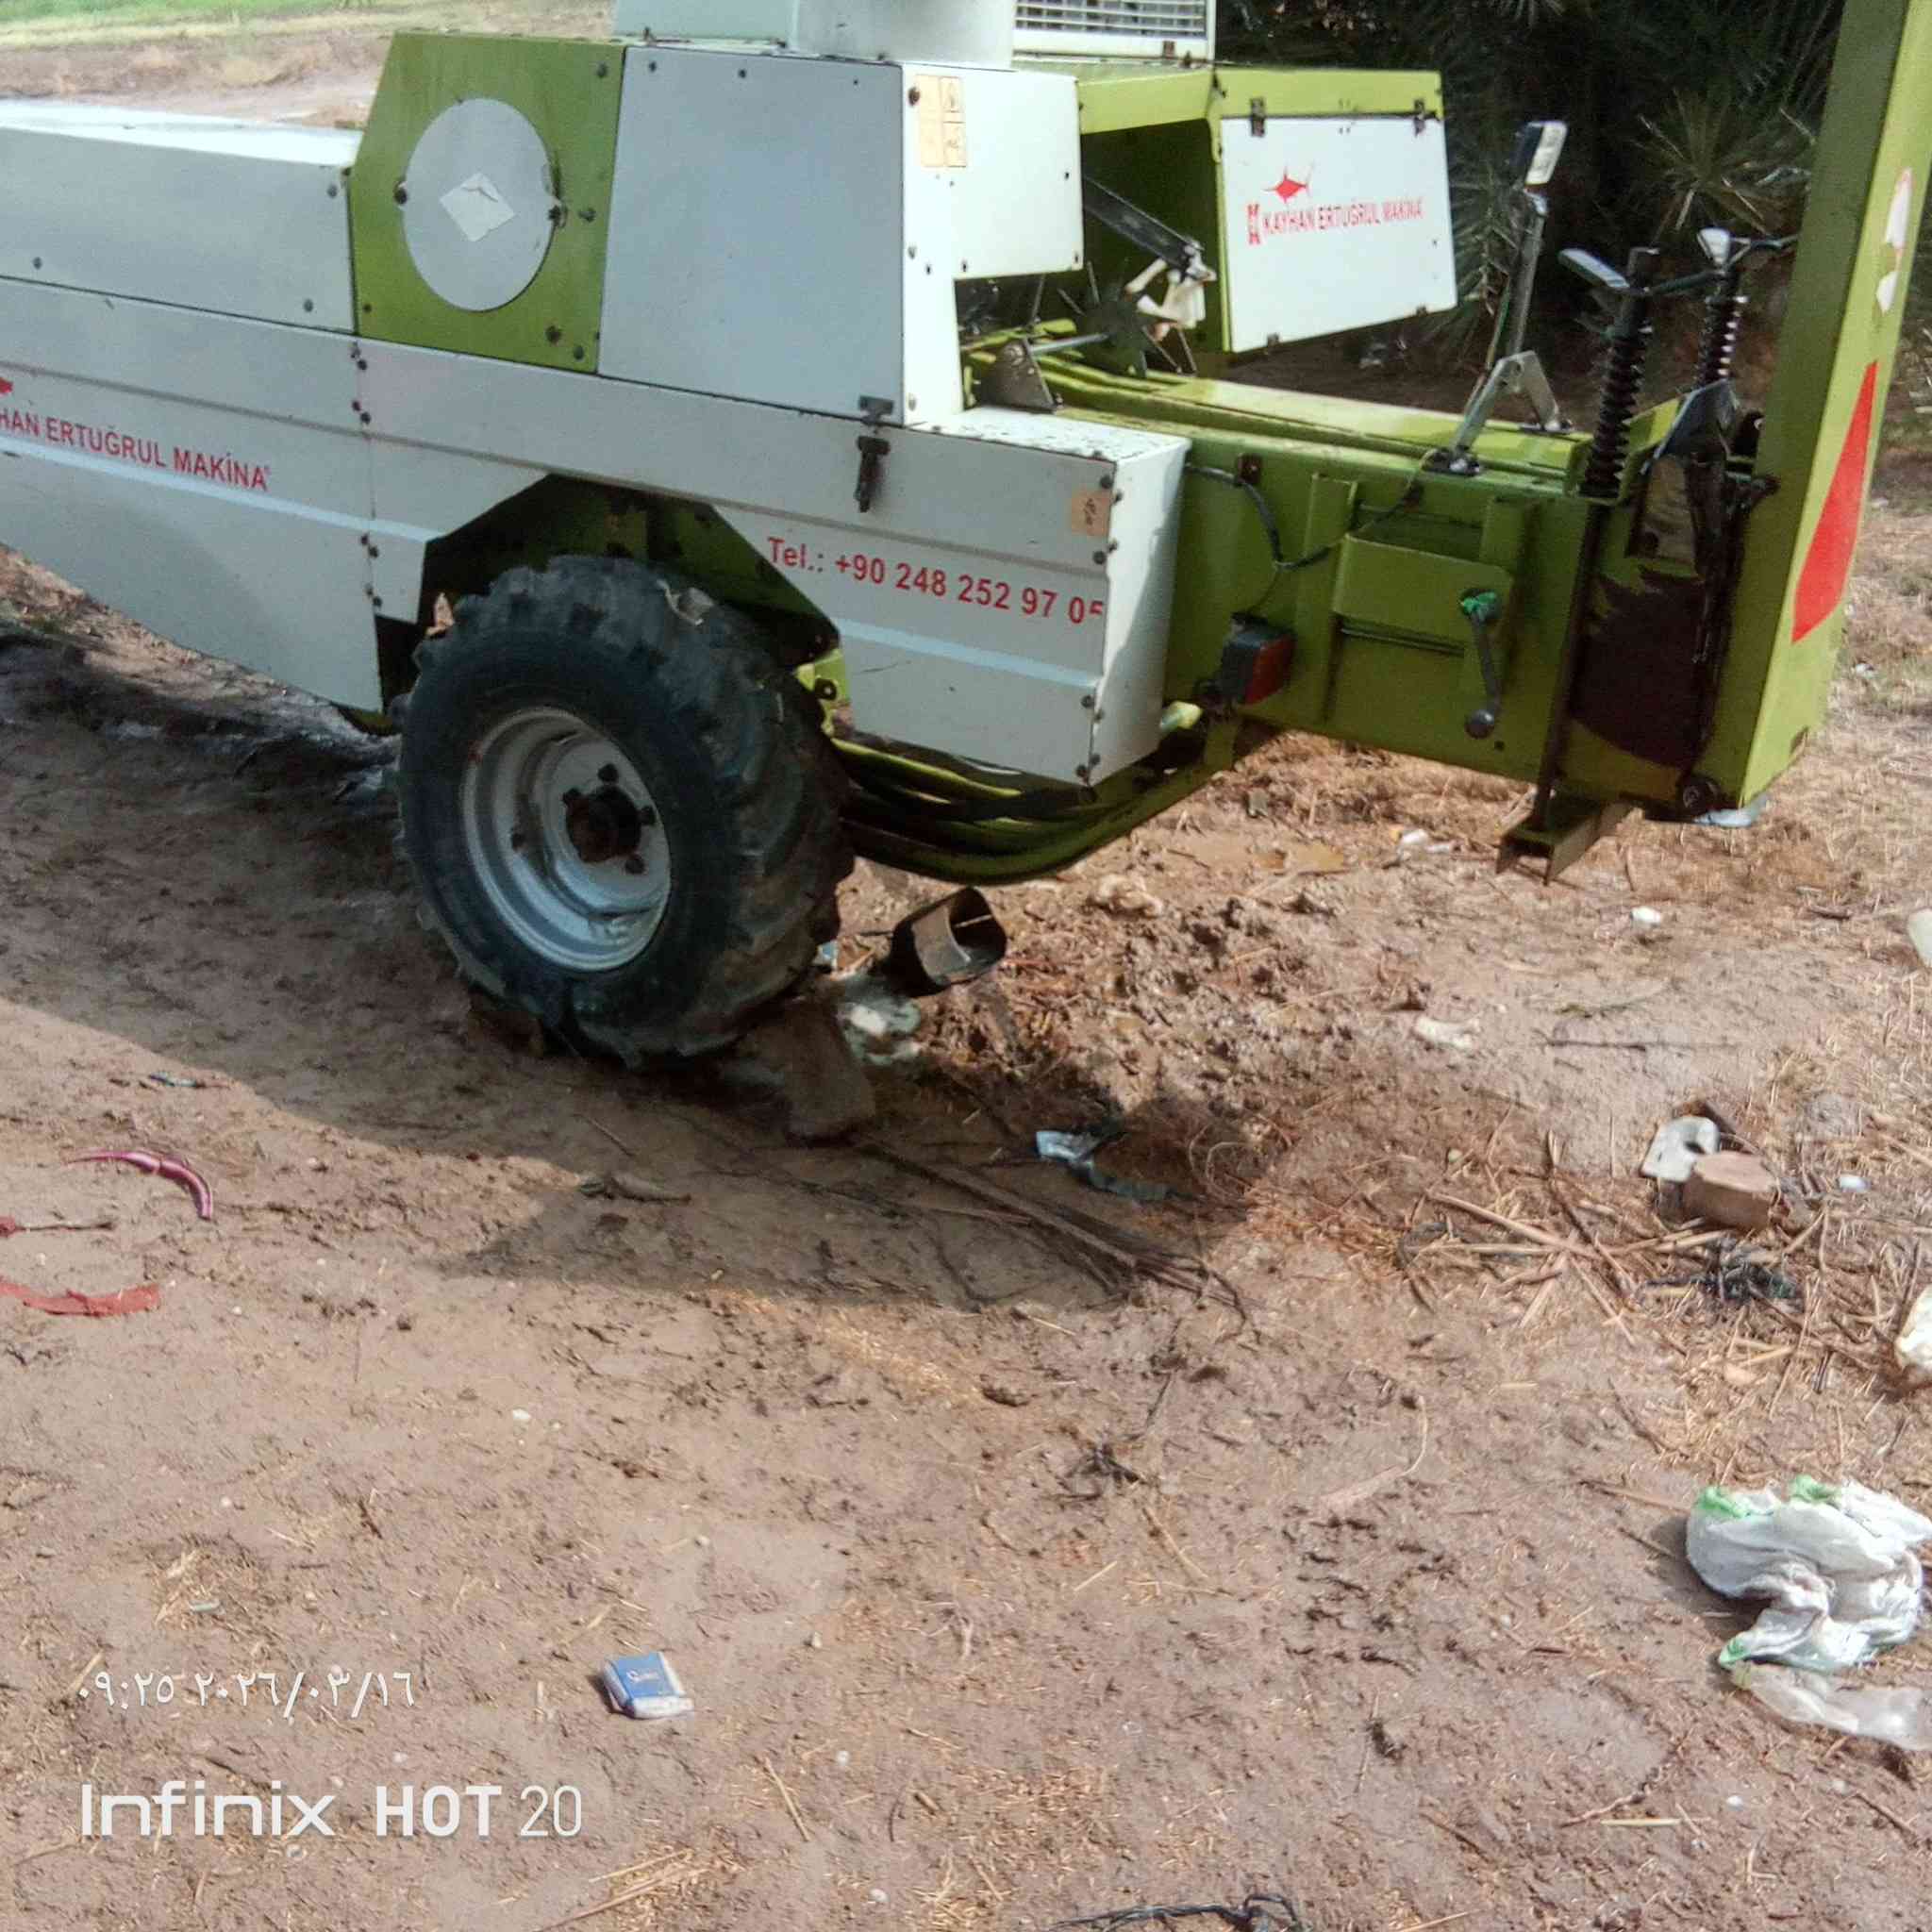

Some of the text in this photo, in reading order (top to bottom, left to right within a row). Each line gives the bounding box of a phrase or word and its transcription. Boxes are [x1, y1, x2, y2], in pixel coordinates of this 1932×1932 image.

[45, 418, 167, 467] ERTUĞRUL
[768, 537, 824, 573] Tel.:
[835, 554, 886, 584] +90
[896, 563, 946, 596] 248
[958, 575, 1010, 609] 252
[1022, 587, 1058, 617] 97
